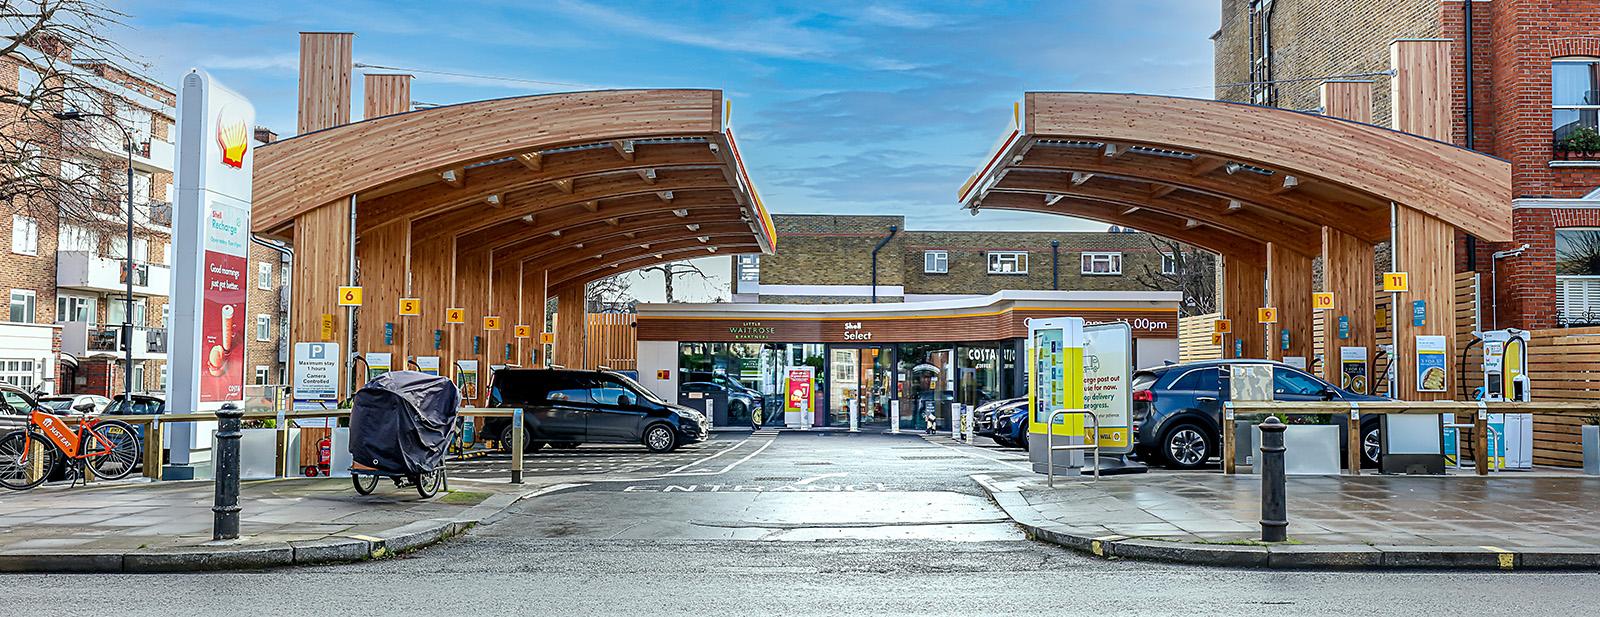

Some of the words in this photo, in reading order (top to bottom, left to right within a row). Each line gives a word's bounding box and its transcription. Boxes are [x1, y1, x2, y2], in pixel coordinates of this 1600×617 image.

[212, 219, 237, 235] Recharge
[210, 263, 222, 274] Good
[222, 267, 240, 280] mornings
[210, 277, 219, 290] just
[226, 280, 240, 290] better.
[1392, 276, 1403, 287] 11
[345, 290, 354, 301] 6
[1318, 296, 1331, 306] 10
[405, 302, 413, 312] 5
[451, 311, 459, 320] 4
[1265, 311, 1272, 320] 9
[488, 319, 495, 328] 3
[844, 322, 862, 330] Shell
[1220, 322, 1227, 331] 8
[519, 328, 525, 336] 2
[844, 331, 872, 340] Select
[1215, 335, 1221, 343] 7
[312, 345, 323, 358] P
[968, 348, 997, 362] COSTA
[1097, 376, 1109, 384] post
[1092, 393, 1115, 401] delivery
[50, 426, 63, 440] JUST
[60, 435, 72, 448] EAT
[624, 484, 892, 492] ENTRANCE
